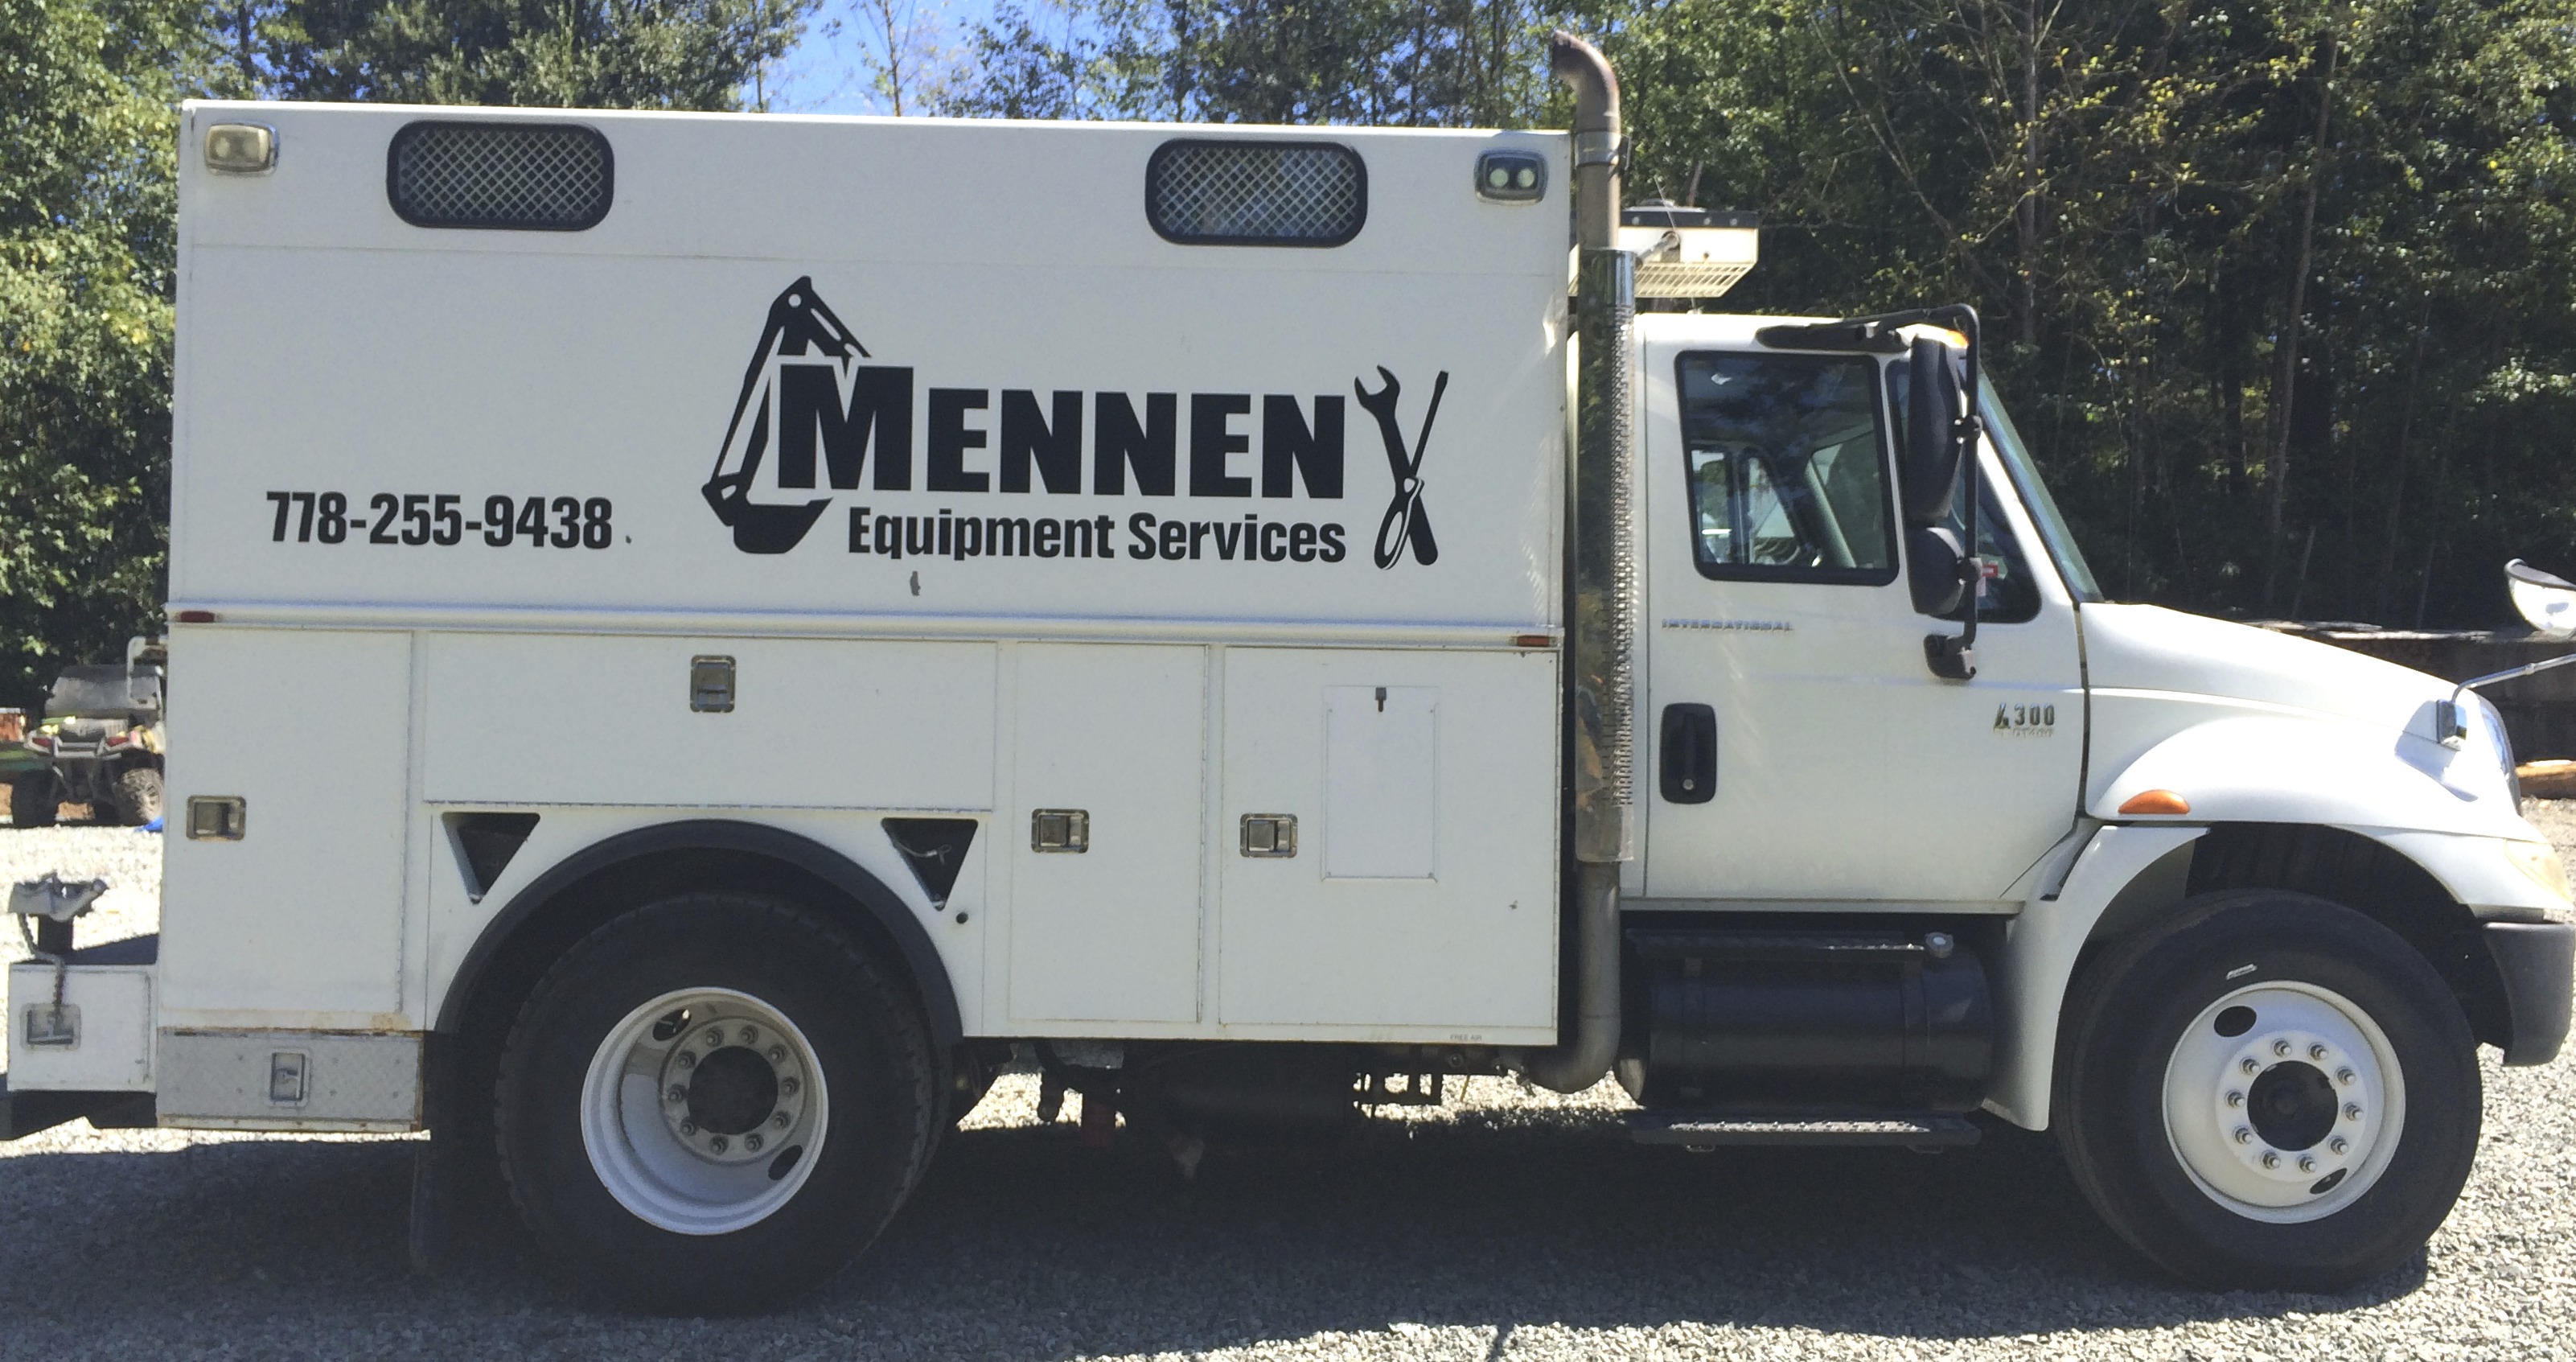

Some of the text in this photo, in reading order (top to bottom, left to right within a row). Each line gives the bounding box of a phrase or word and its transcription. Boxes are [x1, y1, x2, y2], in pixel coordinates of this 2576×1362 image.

[778, 363, 1346, 500] MENNEN
[266, 491, 613, 549] 778-255-9438
[848, 506, 1347, 563] Equipment Services
[1993, 702, 2055, 730] 4300
